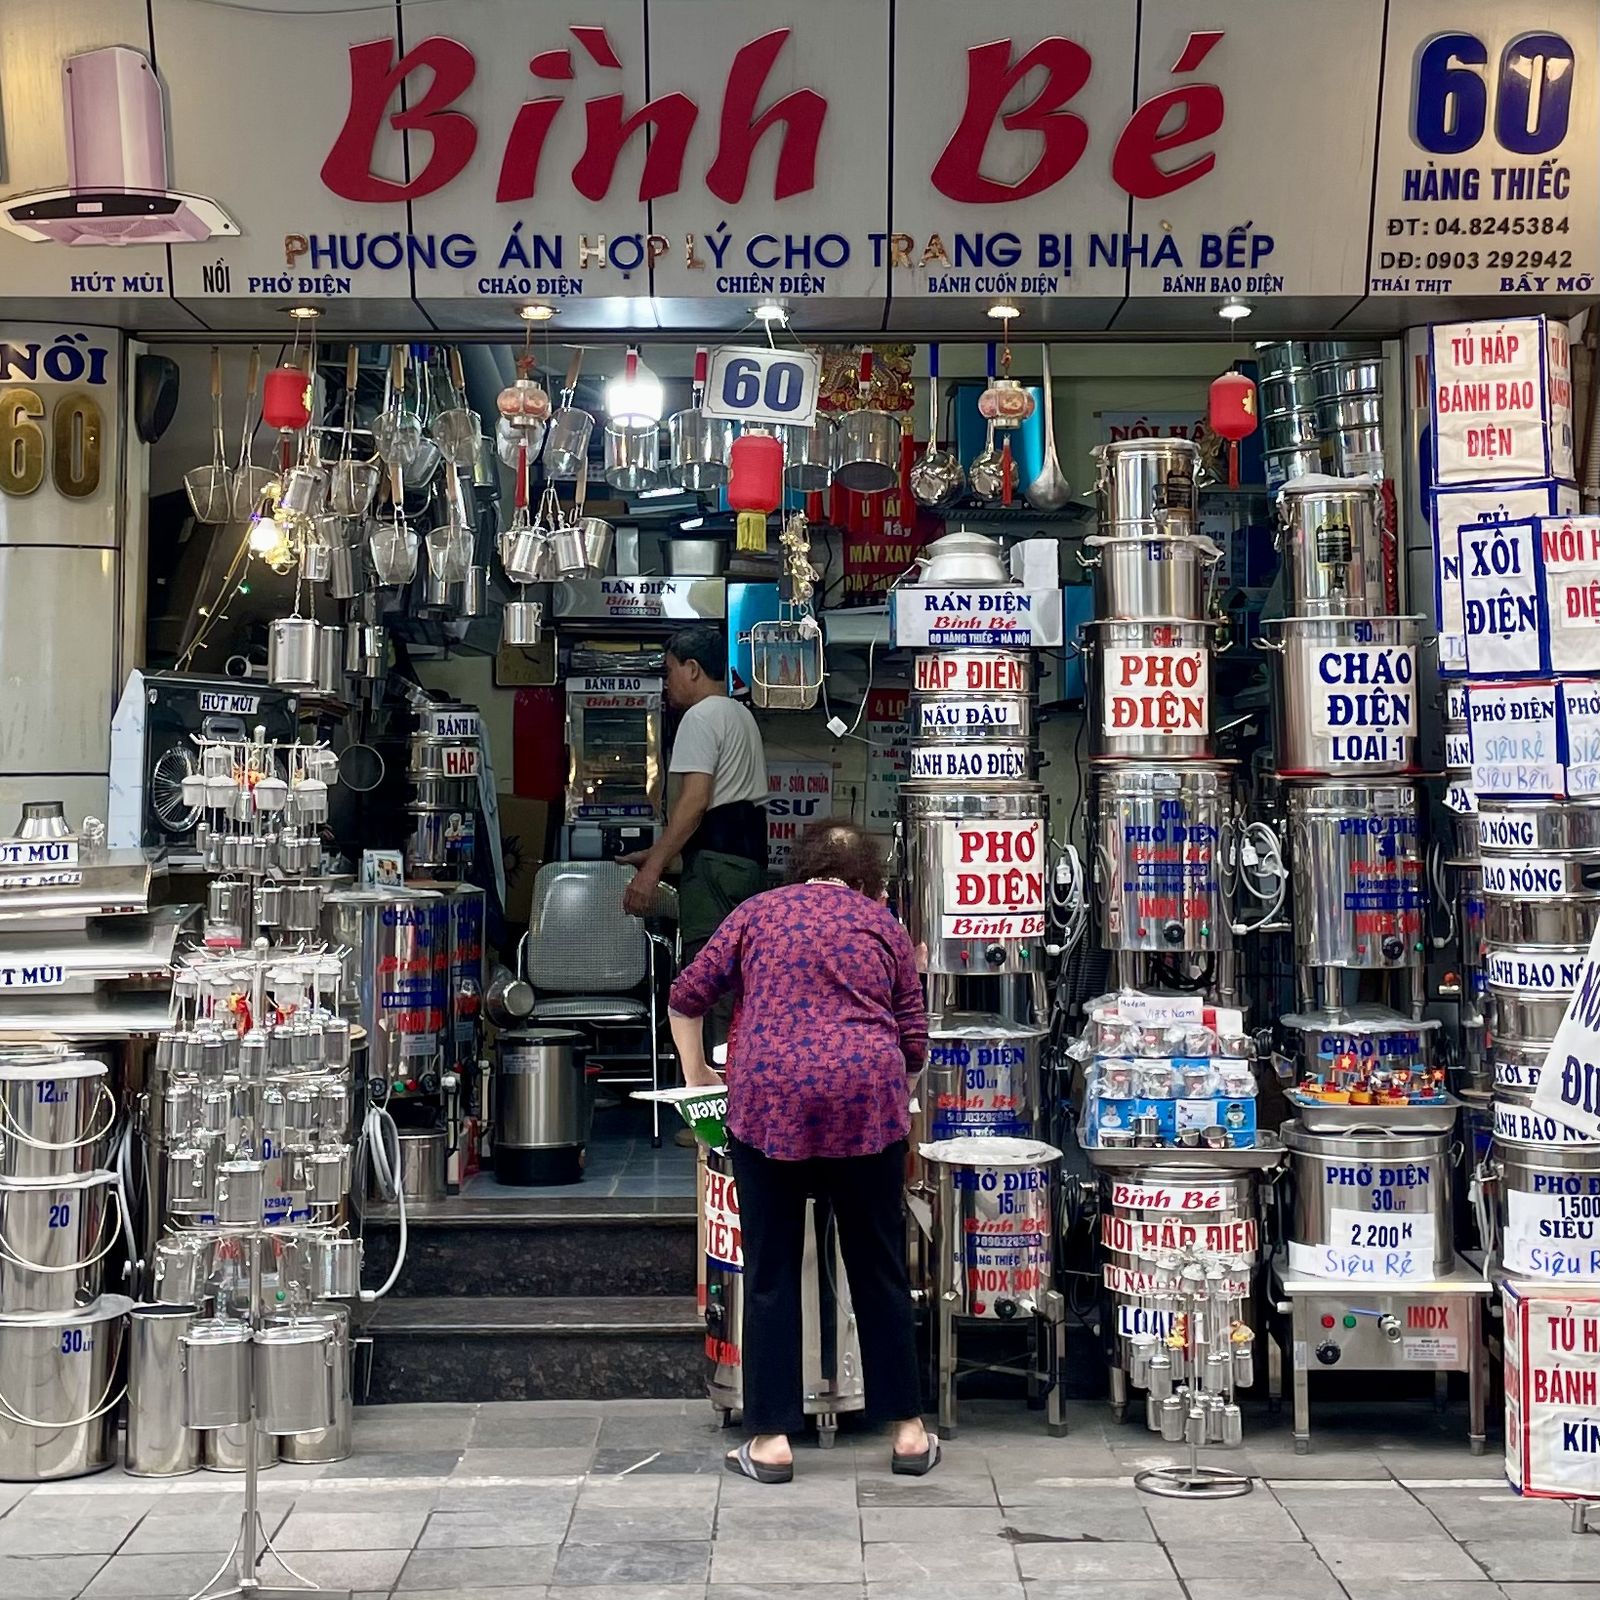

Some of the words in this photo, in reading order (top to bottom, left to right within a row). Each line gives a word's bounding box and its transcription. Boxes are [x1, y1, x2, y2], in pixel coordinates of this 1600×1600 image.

[1414, 33, 1575, 155] 60
[320, 24, 827, 204] Bình
[930, 31, 1225, 204] Bé
[1403, 161, 1480, 201] HÀNG
[1491, 158, 1571, 201] THIẾC
[1388, 218, 1429, 236] ĐT:
[1436, 217, 1570, 235] 04.8245384
[284, 232, 477, 270] PHƯƠNG
[500, 220, 563, 270] ÁN
[579, 232, 670, 280] HỢP
[685, 221, 732, 270] LÝ
[746, 233, 851, 270] CHO
[868, 232, 1022, 268] TRANG
[1039, 233, 1072, 277] BỊ
[1089, 219, 1183, 268] NHÀ
[1200, 220, 1275, 268] BẾP
[1380, 253, 1421, 270] DĐ:
[1426, 252, 1479, 269] 0903
[1487, 251, 1572, 268] 292942
[70, 271, 116, 293] HÚT
[123, 271, 164, 293] MÙI
[202, 257, 231, 294] NỒI
[248, 272, 295, 294] PHỞ
[299, 272, 351, 296] ĐIỆN
[478, 275, 531, 295] CHÁO
[536, 275, 583, 297] ĐIỆN
[716, 272, 775, 294] CHIÊN
[779, 272, 826, 296] ĐIỆN
[928, 275, 971, 294] BÁNH
[975, 270, 1017, 294] CUỐN
[1021, 273, 1059, 296] ĐIỆN
[1162, 274, 1206, 294] BÁNH
[1211, 275, 1242, 293] BAO
[1249, 273, 1285, 296] ĐIỆN
[1372, 275, 1411, 292] THÁI
[1416, 279, 1452, 296] THỊT
[1451, 327, 1474, 367] TỦ
[1481, 324, 1519, 365] HẤP
[0, 333, 108, 385] NỒI
[722, 358, 804, 412] 60
[1438, 379, 1490, 414] BÁNH
[1496, 381, 1534, 411] BAO
[0, 388, 102, 498] 60
[1467, 423, 1513, 460] ĐIỆN
[1470, 528, 1521, 577] XÔI
[925, 590, 972, 612] RÁN
[978, 590, 1032, 615] ĐIỆN
[1466, 587, 1537, 640] ĐIỆN
[933, 613, 982, 629] Bình
[988, 616, 1018, 630] Bé
[1354, 622, 1373, 643] 50
[1120, 651, 1202, 688] PHỞ
[1318, 648, 1413, 685] CHÁO
[1112, 689, 1204, 734] ĐIỆN
[1327, 686, 1411, 733] ĐIỆN
[1510, 696, 1555, 723] ĐIỆN
[947, 753, 982, 775] BAO
[958, 821, 1039, 863] PHỞ
[1489, 816, 1534, 846] NÓNG
[28, 840, 70, 862] MÙI
[956, 867, 1043, 911] ĐIỆN
[1508, 863, 1562, 892] NÓNG
[951, 916, 1013, 936] Bình
[1518, 963, 1555, 988] BAO
[977, 1043, 1026, 1069] ĐIỆN
[37, 1081, 56, 1103] 12
[966, 1069, 985, 1090] 30
[686, 1097, 728, 1121] eken
[1520, 1115, 1557, 1142] BAO
[1003, 1165, 1050, 1194] ĐIỆN
[1327, 1162, 1374, 1187] PHỞ
[1379, 1163, 1431, 1190] ĐIỆN
[1532, 1172, 1583, 1195] PHỞ
[997, 1192, 1014, 1215] 15
[1113, 1185, 1172, 1209] Bình
[1181, 1190, 1220, 1209] Bé
[1371, 1188, 1393, 1211] 30
[48, 1204, 70, 1228] 20
[1539, 1216, 1593, 1240] SIÊU
[966, 1268, 1009, 1292] INOX
[1407, 1305, 1449, 1329] INOX
[1548, 1305, 1576, 1352] TỦ
[61, 1329, 83, 1354] 30
[1534, 1363, 1598, 1406] BÁNH
